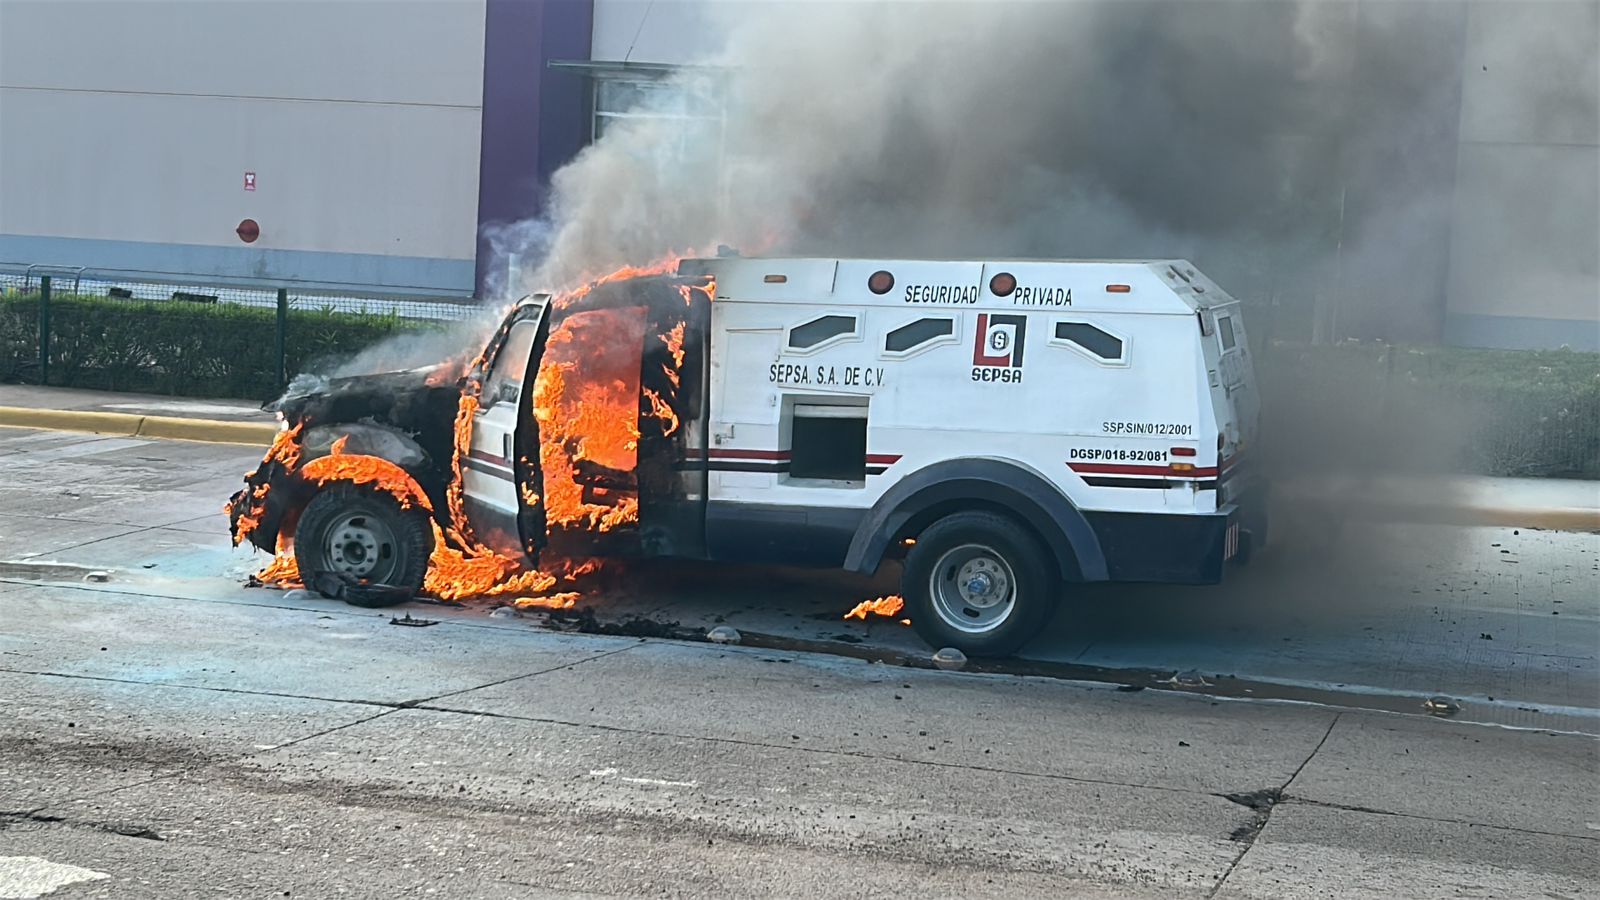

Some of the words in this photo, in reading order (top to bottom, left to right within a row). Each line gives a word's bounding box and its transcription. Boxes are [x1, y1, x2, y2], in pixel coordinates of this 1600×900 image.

[905, 285, 977, 304] SEGURIDAD
[1014, 287, 1072, 306] PRIVADA
[817, 366, 839, 385] S.A.
[845, 367, 860, 386] DE
[865, 368, 885, 387] C.V.
[971, 368, 1022, 383] SEPSA
[1070, 448, 1167, 461] DGSP/018-92/081
